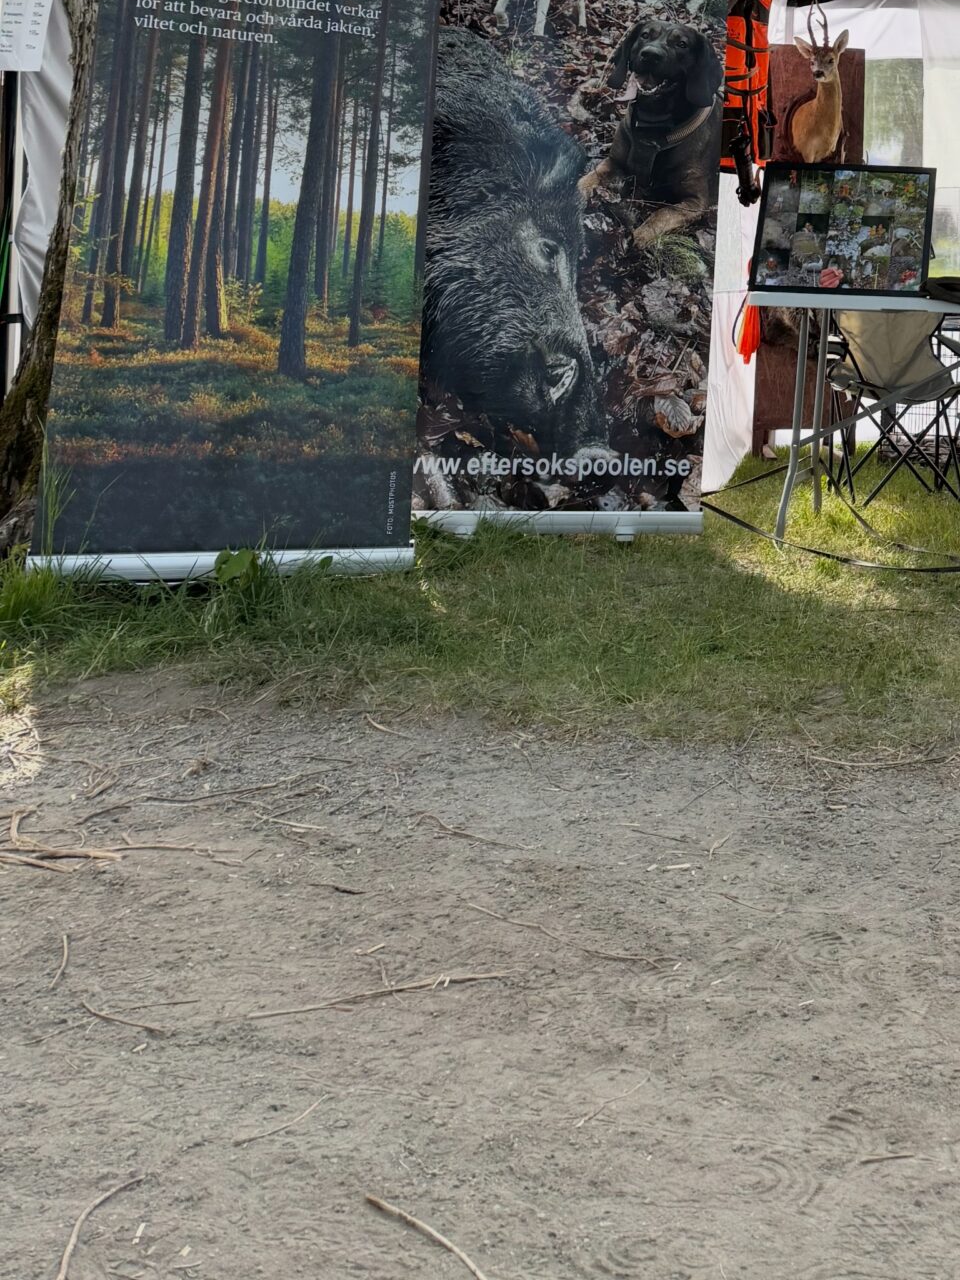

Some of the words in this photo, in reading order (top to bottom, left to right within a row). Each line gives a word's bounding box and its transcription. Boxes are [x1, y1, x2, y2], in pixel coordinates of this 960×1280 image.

[163, 1, 186, 14] att
[190, 1, 241, 21] bevara
[246, 11, 274, 25] och
[279, 13, 322, 30] vårda
[324, 18, 376, 38] jakten,
[334, 4, 382, 20] verkar
[134, 14, 175, 31] viltet
[179, 21, 208, 35] och
[212, 26, 279, 44] naturen.
